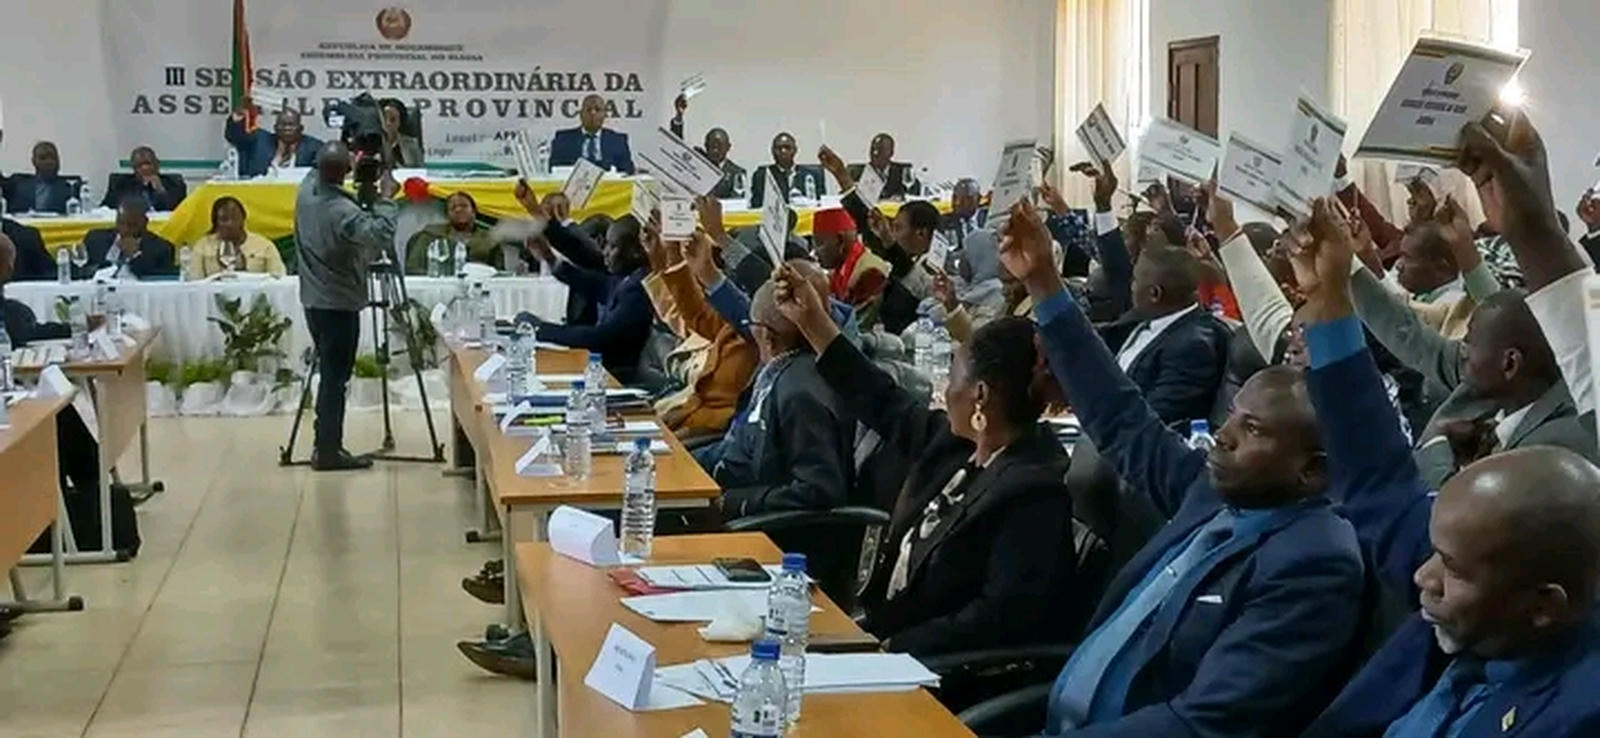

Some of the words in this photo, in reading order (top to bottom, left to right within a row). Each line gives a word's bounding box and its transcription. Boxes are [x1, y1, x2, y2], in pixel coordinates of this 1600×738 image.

[165, 67, 186, 87] III
[195, 64, 316, 89] SESÃO
[326, 65, 597, 92] EXTRAORDINÁRIA
[604, 72, 644, 92] DA
[412, 98, 643, 118] PROVINCAL
